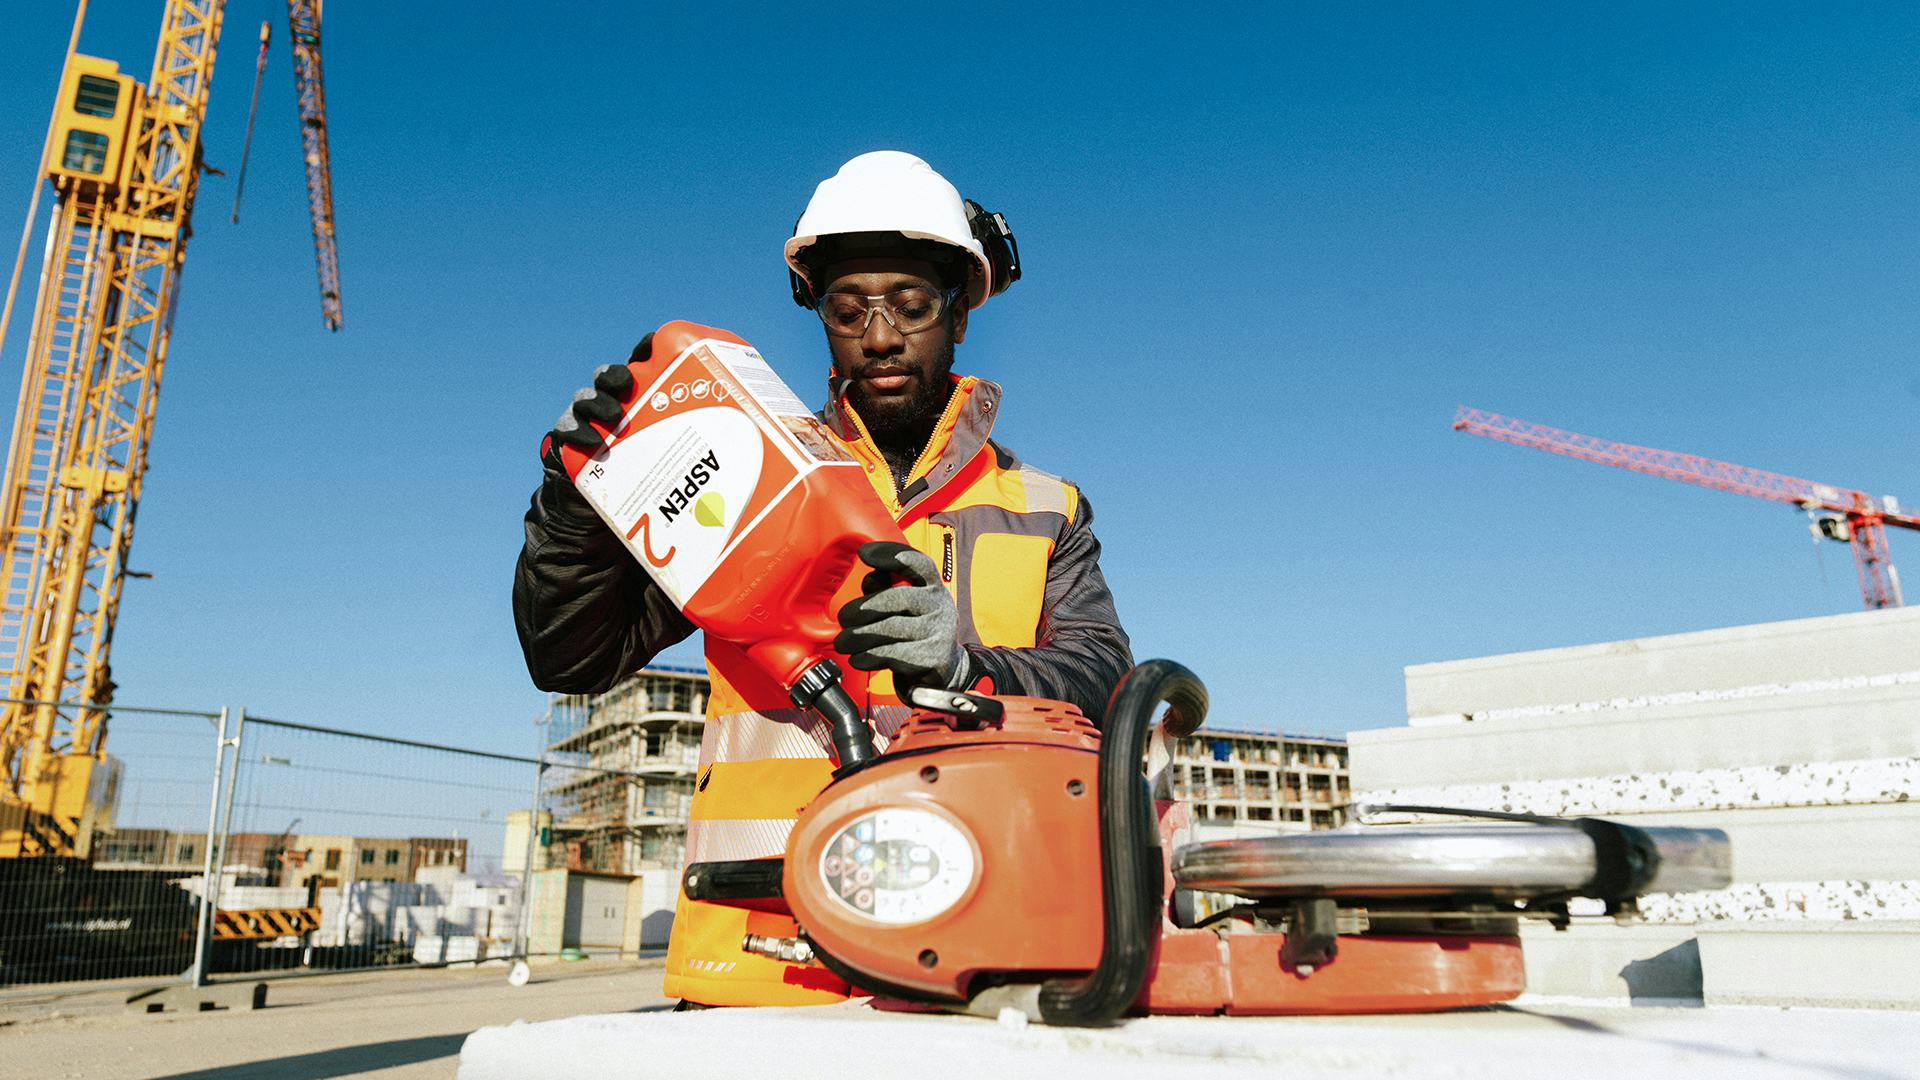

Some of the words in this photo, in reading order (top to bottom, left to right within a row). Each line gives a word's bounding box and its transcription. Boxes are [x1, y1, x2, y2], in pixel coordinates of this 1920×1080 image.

[589, 464, 605, 480] 5L
[658, 449, 720, 523] ASPEN
[626, 512, 676, 568] 2
